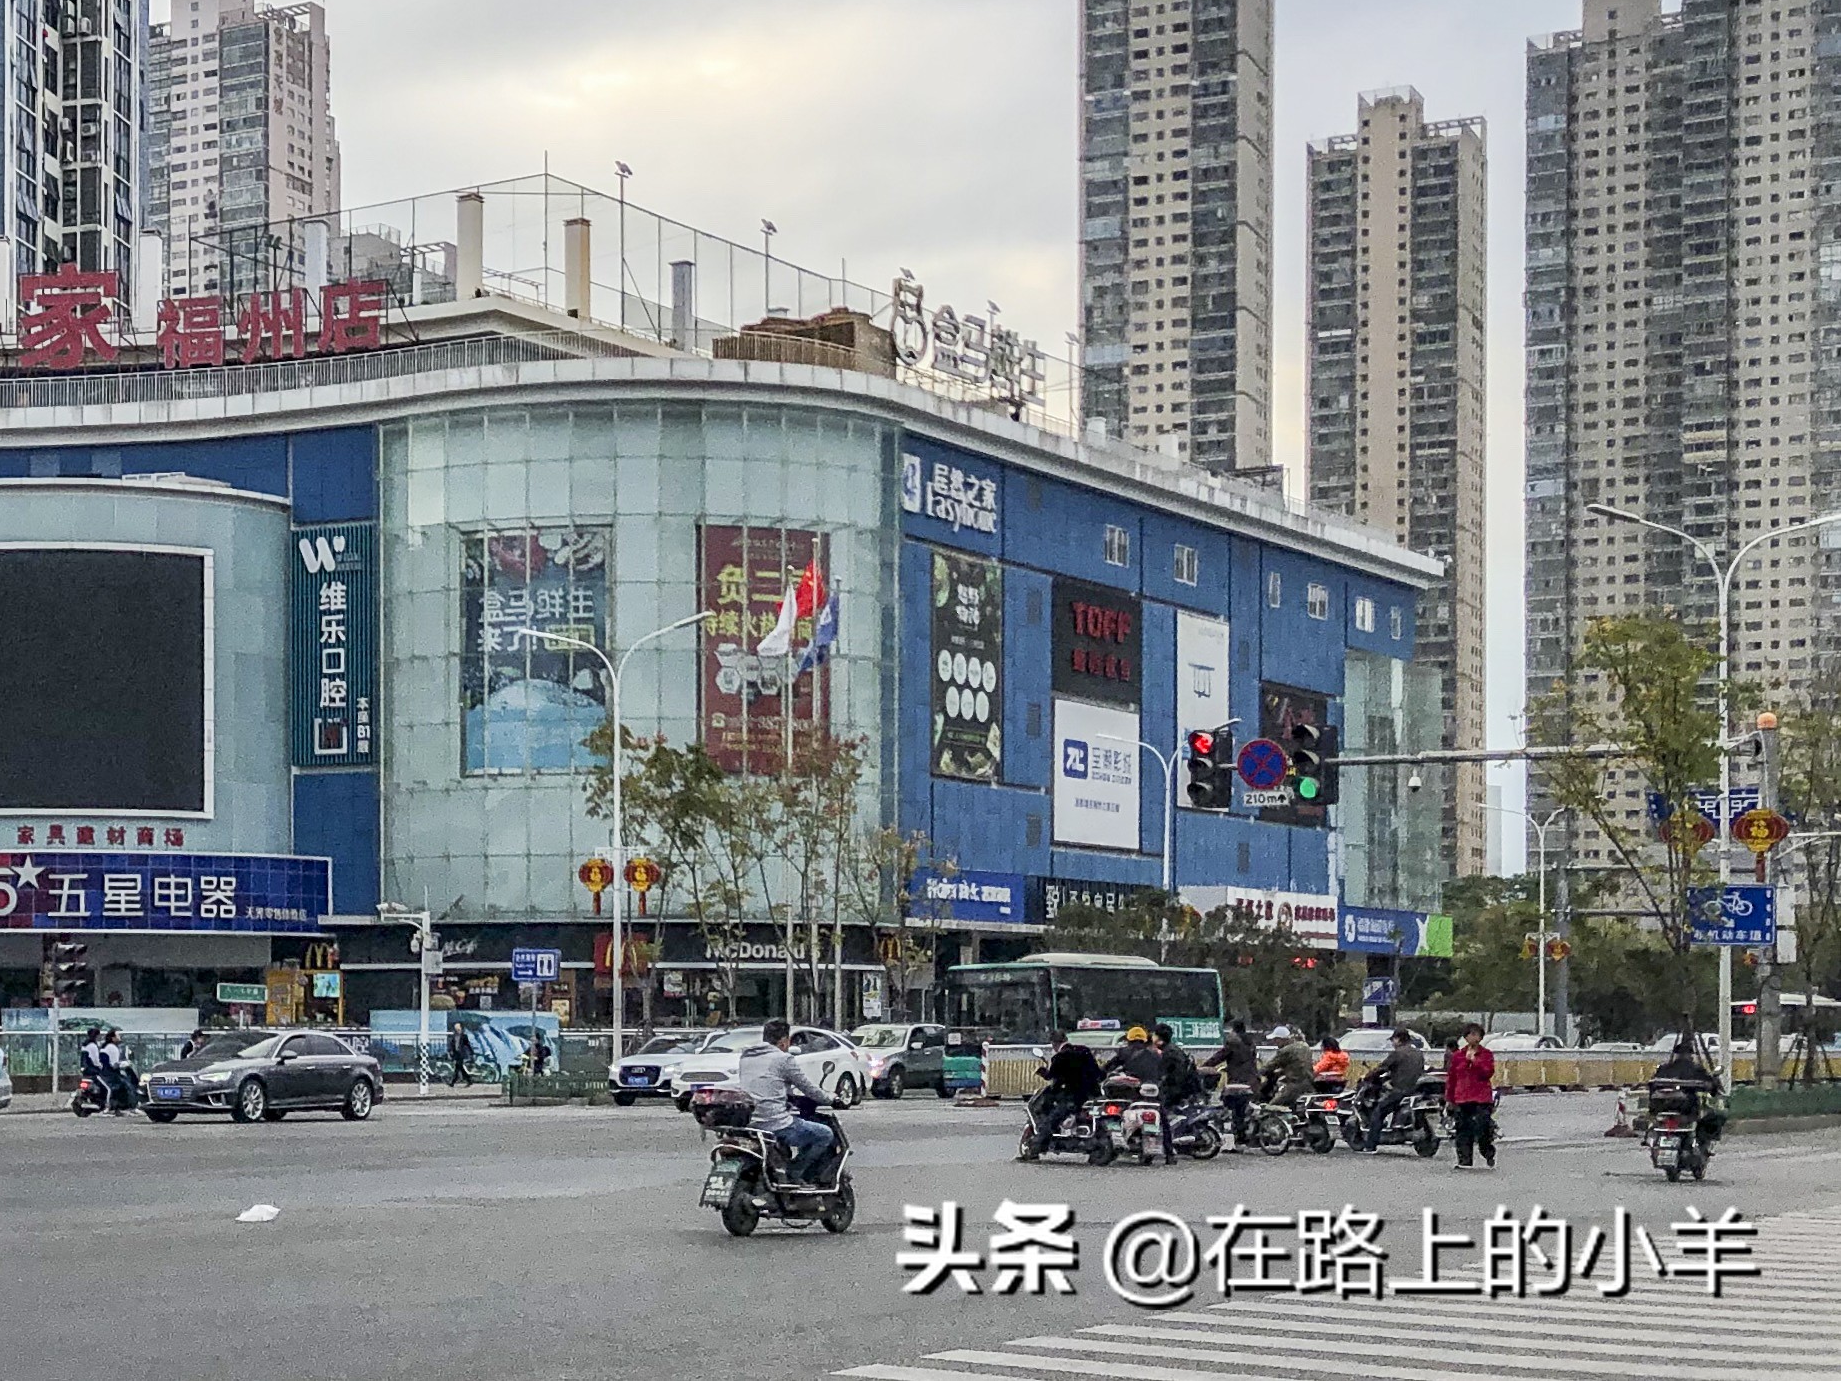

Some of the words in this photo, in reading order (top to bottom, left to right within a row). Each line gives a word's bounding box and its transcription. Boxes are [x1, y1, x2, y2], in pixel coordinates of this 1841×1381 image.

[159, 279, 391, 367] 福州店
[932, 463, 997, 511] 居然之家
[478, 587, 595, 623] 盒马鲜生
[318, 581, 347, 709] 维乐口腔
[1245, 793, 1278, 805] 210m
[17, 825, 185, 848] 家具建材商场
[47, 873, 237, 918] 五星电器
[705, 941, 821, 960] McDonads
